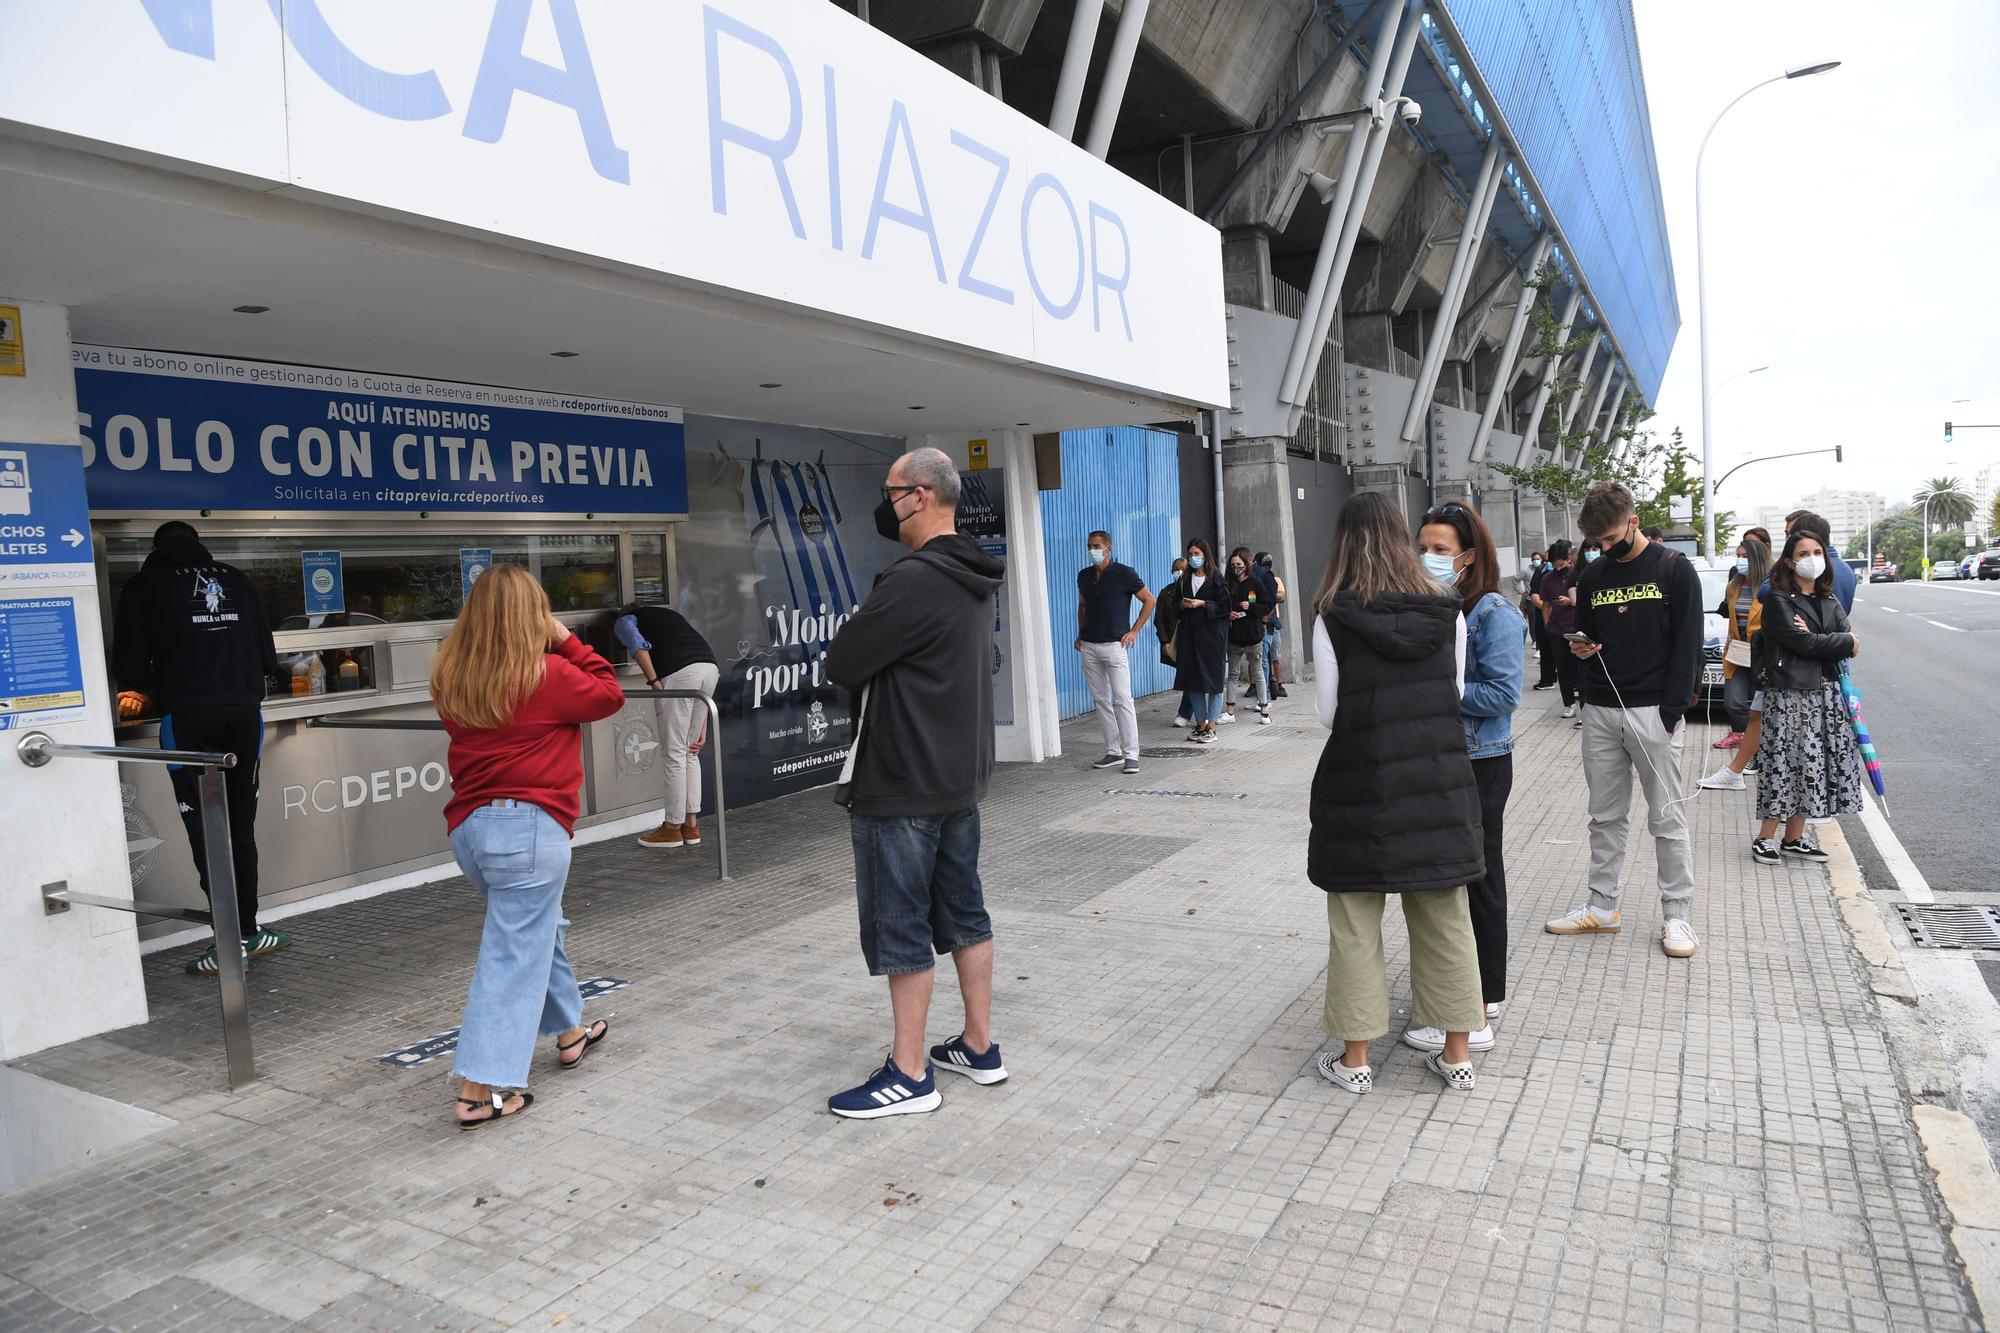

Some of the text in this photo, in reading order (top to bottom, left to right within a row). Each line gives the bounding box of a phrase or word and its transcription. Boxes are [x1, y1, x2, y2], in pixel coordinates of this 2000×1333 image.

[703, 6, 1134, 343] RIAZOR
[107, 351, 126, 366] tu
[133, 353, 188, 372] abono
[194, 361, 245, 377] online
[250, 367, 342, 387] gestionando
[347, 375, 359, 388] la
[363, 378, 402, 393] Cuota
[406, 382, 421, 395] de
[426, 384, 472, 400] Reserva
[476, 391, 490, 402] en
[493, 392, 534, 405] nuestra
[537, 397, 559, 408] web
[561, 398, 669, 418] rcdeportivo.es/abonos
[327, 401, 491, 431] AQUÍ ATENDEMOS
[259, 424, 373, 478] CON
[392, 433, 497, 482] CITA
[511, 441, 654, 487] PREVIA
[274, 486, 544, 505] Solicítala en citaprevia.rcdeportivo.es
[0, 526, 46, 538] CHOS
[746, 662, 807, 709] por
[283, 761, 453, 819] RCDEPO
